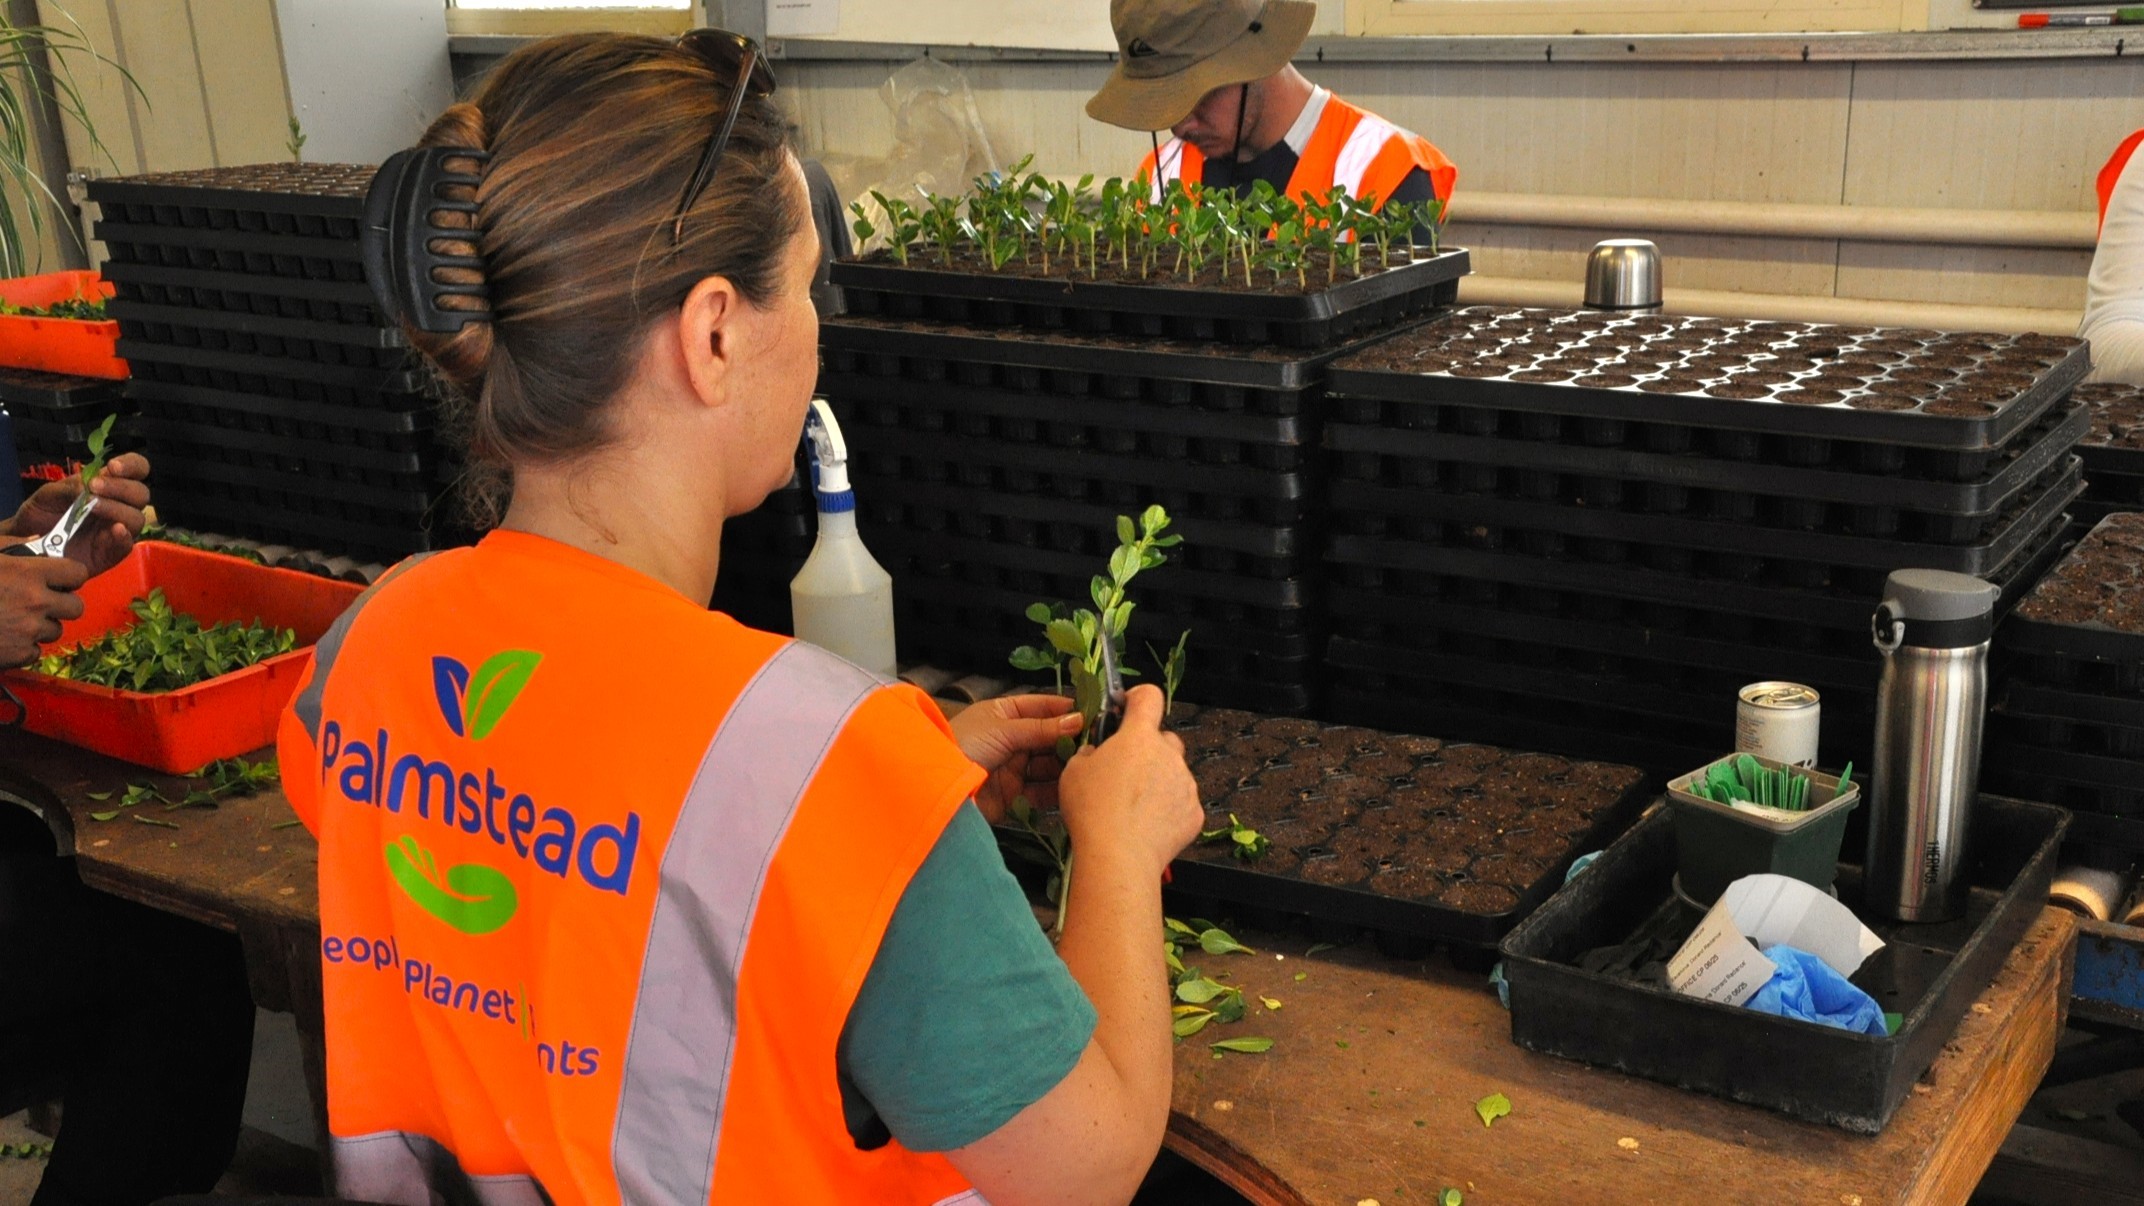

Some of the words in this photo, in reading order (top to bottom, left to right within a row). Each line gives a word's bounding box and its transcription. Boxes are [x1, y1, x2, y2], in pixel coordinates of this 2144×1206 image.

[322, 720, 641, 896] Palmstead
[1925, 841, 1940, 884] THERMOS
[323, 934, 400, 972] eopl
[405, 959, 516, 1025] Planet
[1678, 975, 1698, 994] OFFICE
